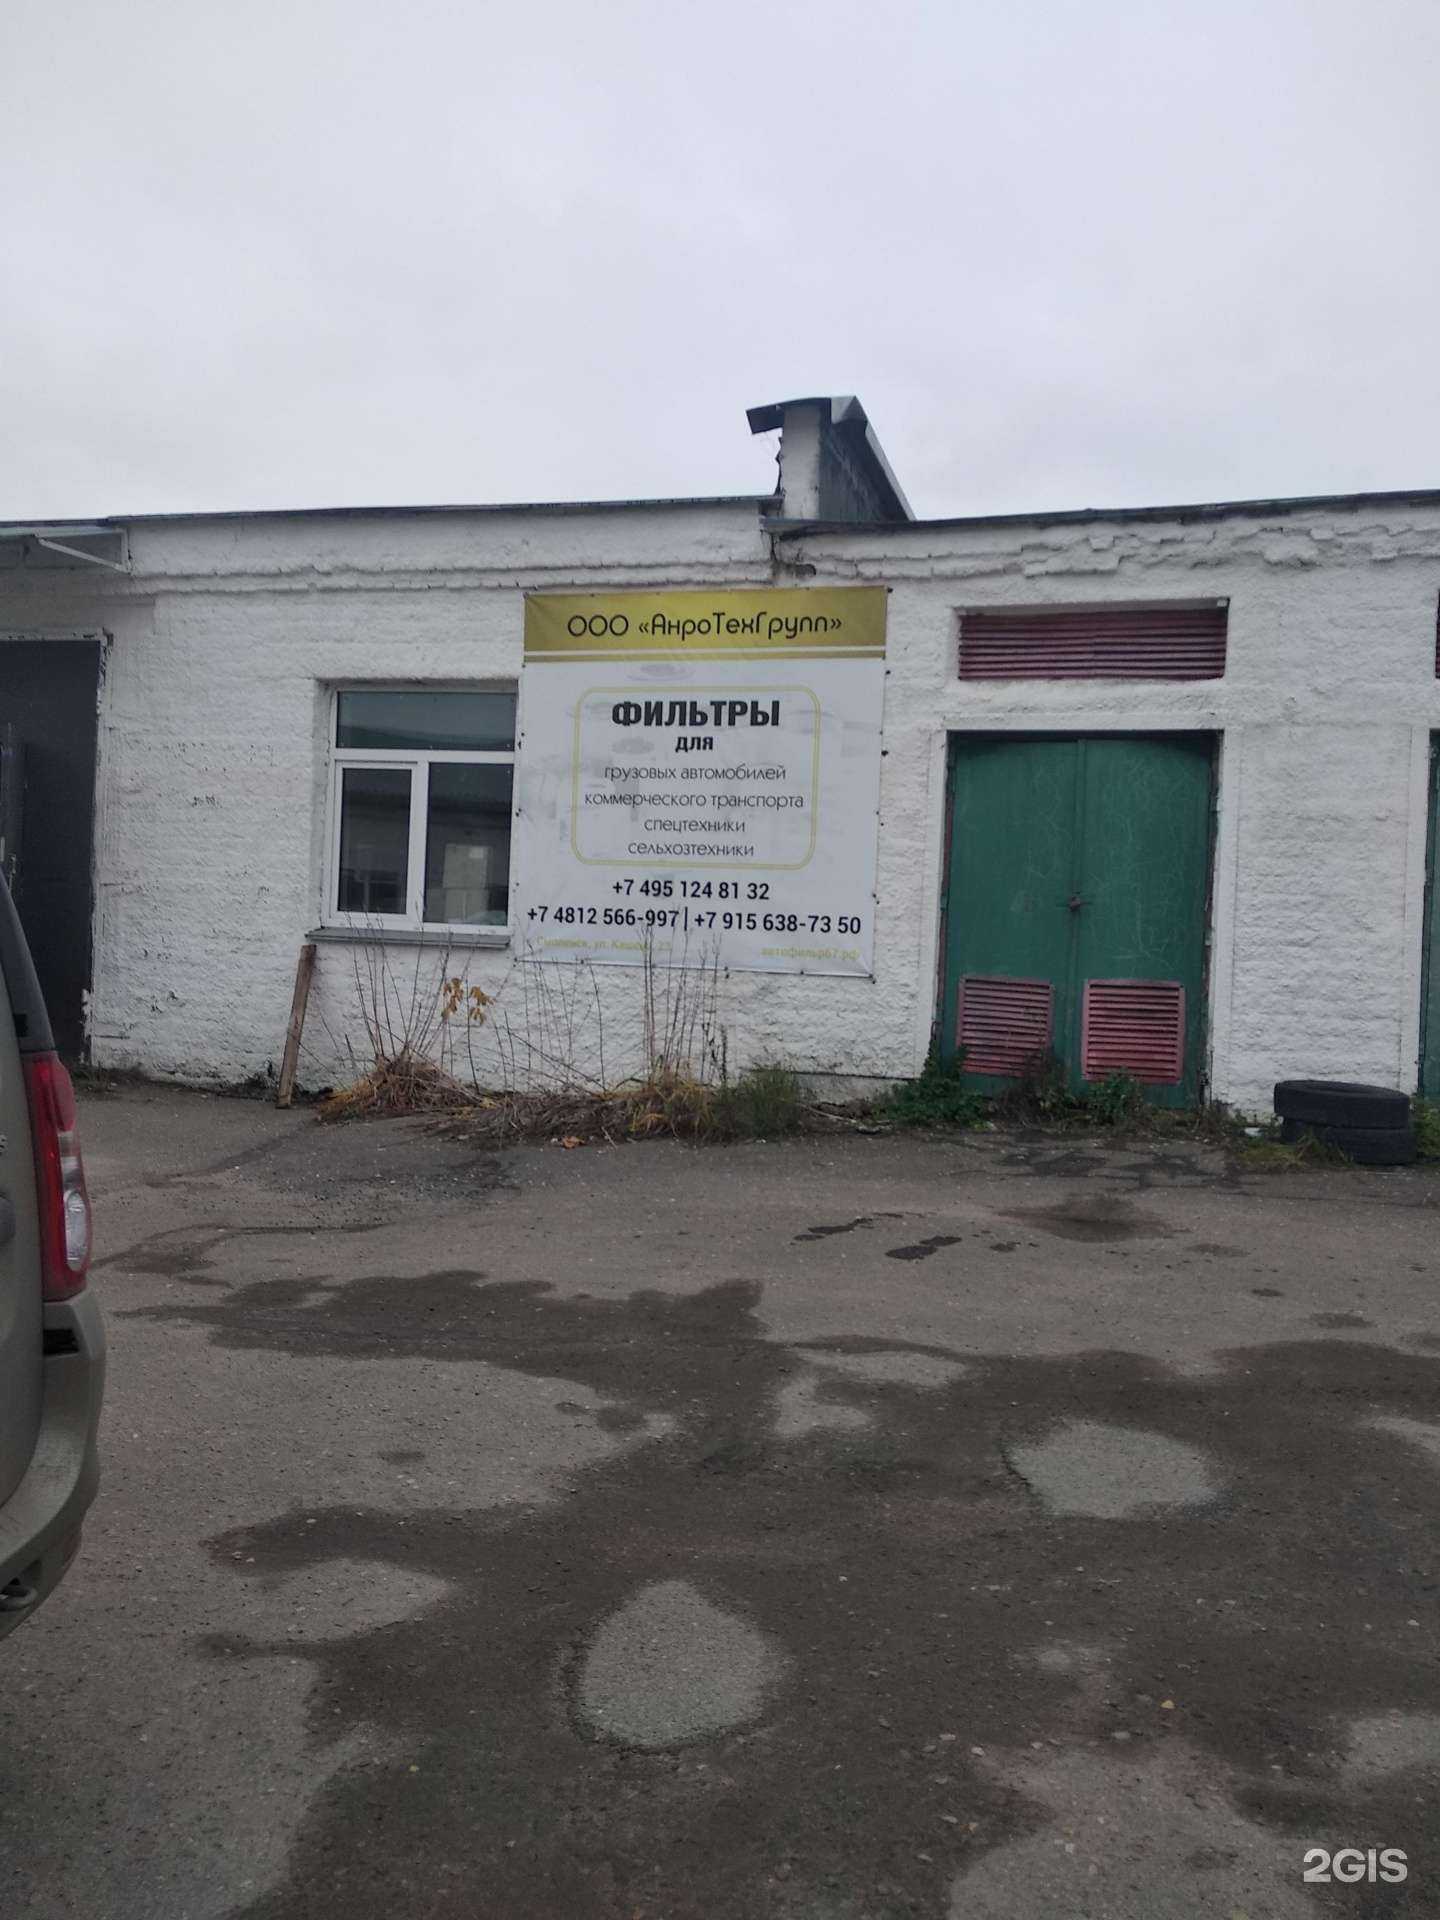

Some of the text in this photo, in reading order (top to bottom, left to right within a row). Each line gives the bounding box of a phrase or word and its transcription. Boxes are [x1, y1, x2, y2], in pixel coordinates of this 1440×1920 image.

[567, 611, 842, 641] ООО «АнроТехГрупп»
[611, 700, 780, 727] ФИЛЬТРЫ
[675, 736, 714, 753] для
[604, 763, 786, 782] грузовых автомобилей
[585, 793, 804, 810] коммерческого транспорта
[643, 819, 745, 832] спецтехники
[627, 841, 754, 857] сельхозтехники
[612, 879, 770, 900] +7 495 124 81 32
[527, 906, 680, 928] +7 4812 566-997
[694, 912, 862, 934] +7 915 638-73 50
